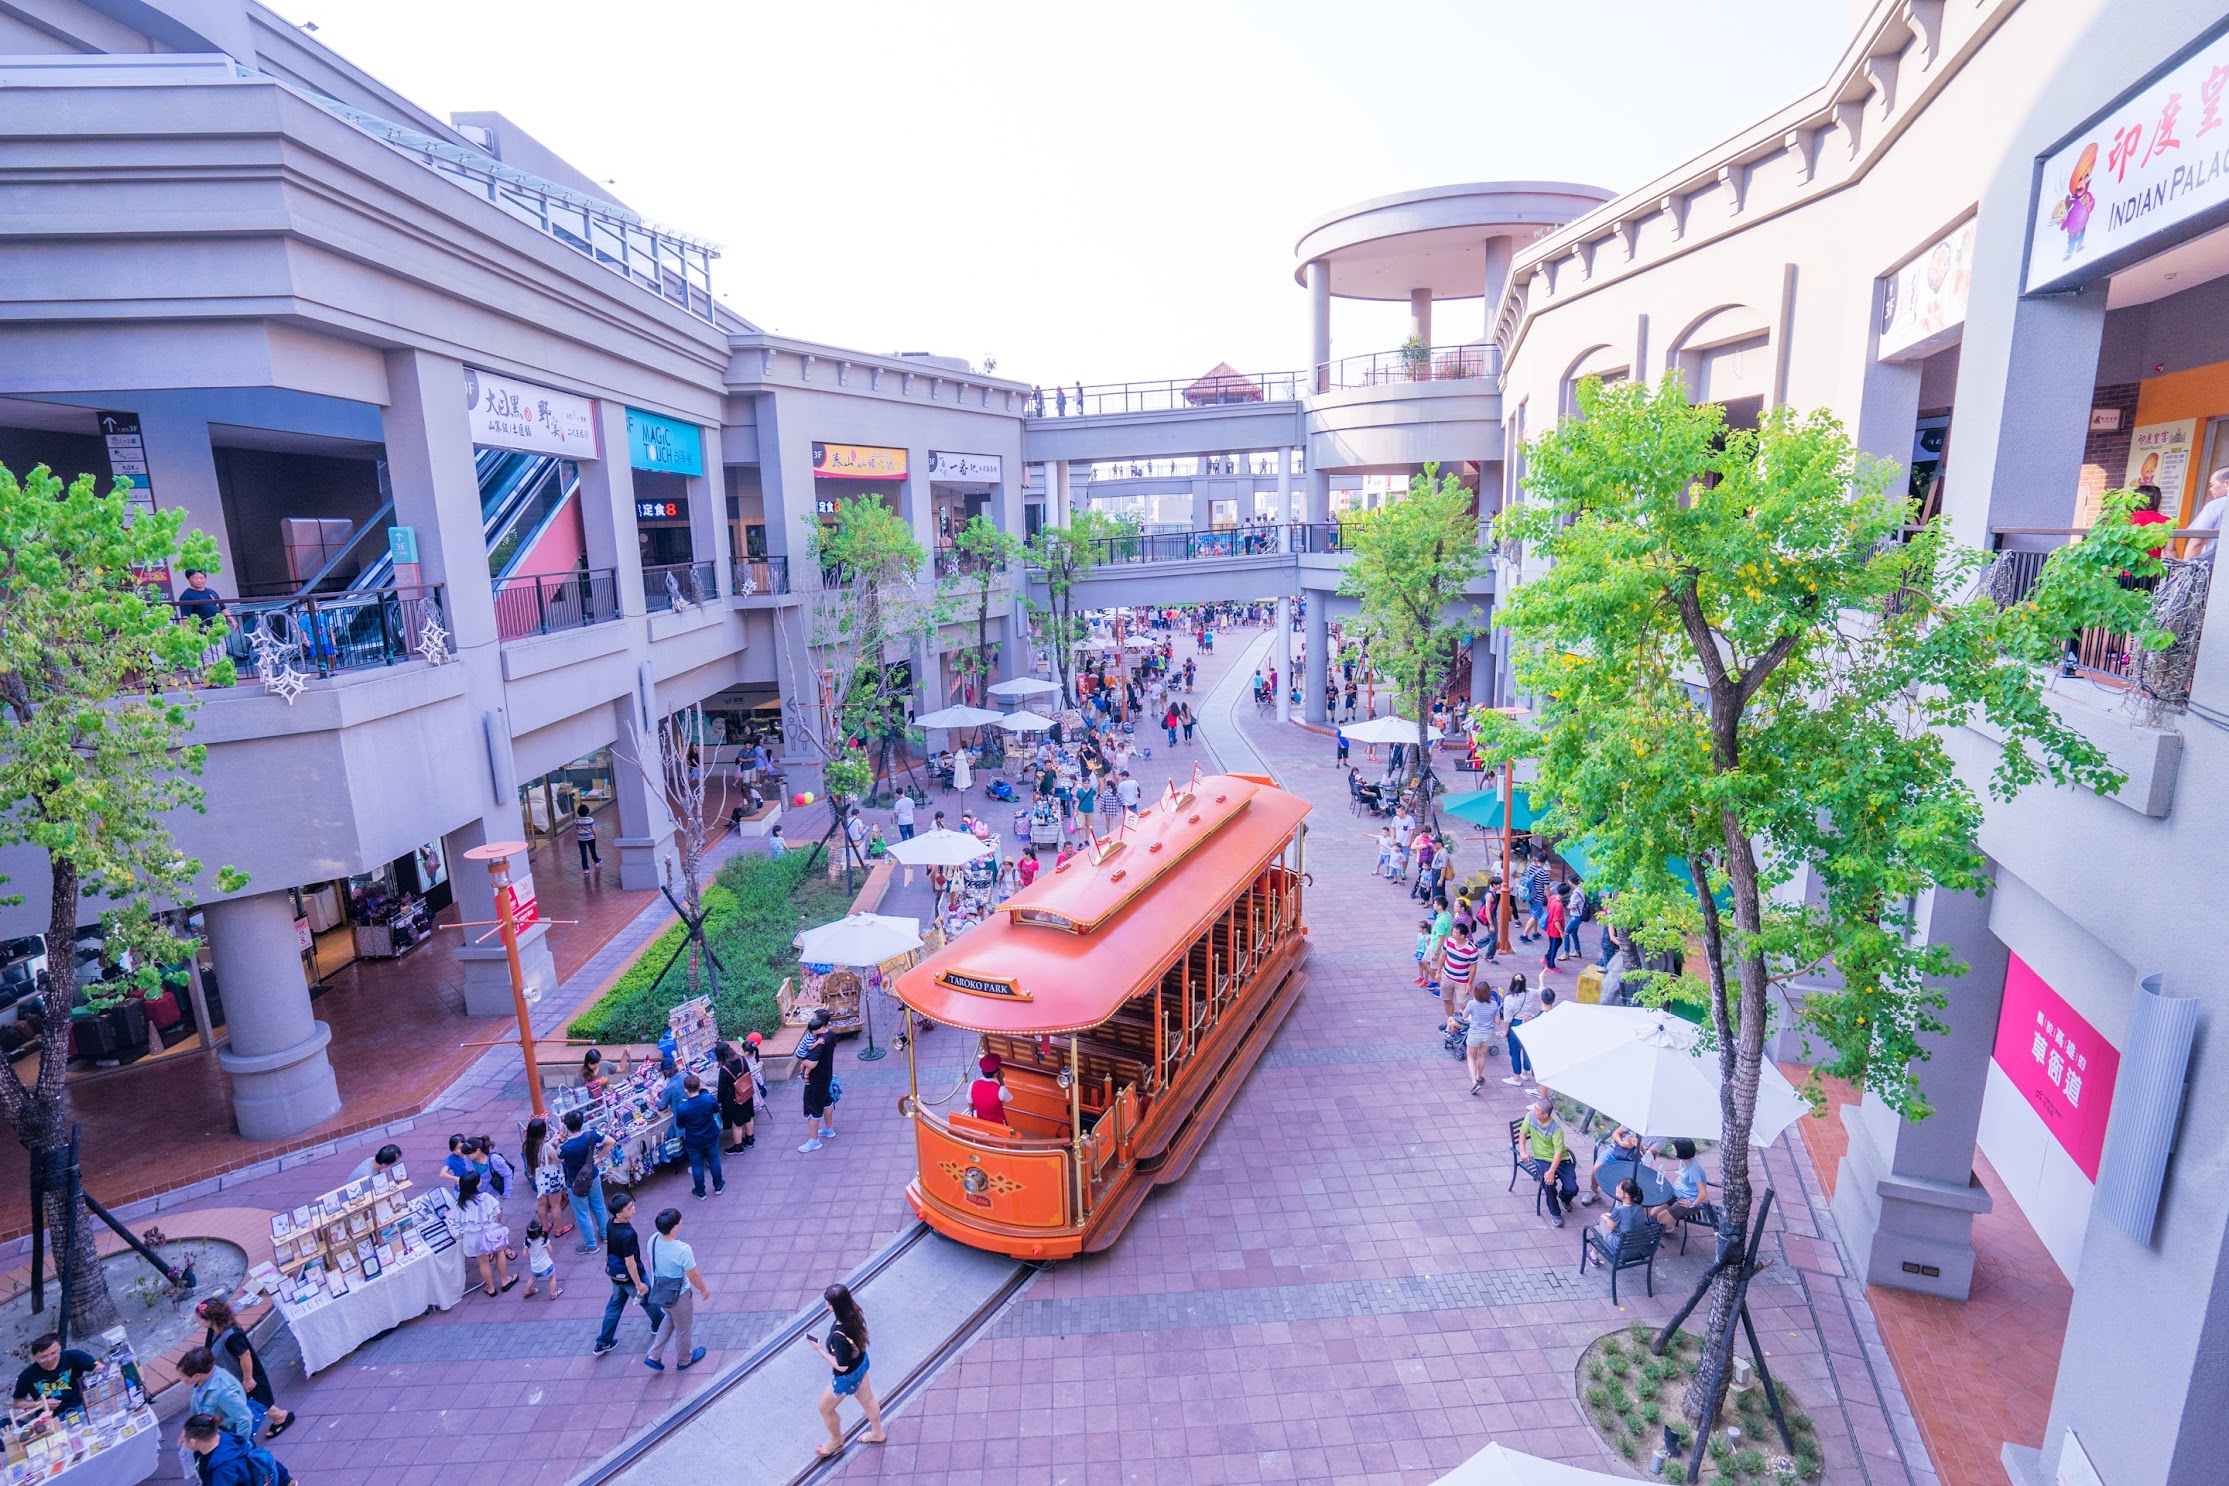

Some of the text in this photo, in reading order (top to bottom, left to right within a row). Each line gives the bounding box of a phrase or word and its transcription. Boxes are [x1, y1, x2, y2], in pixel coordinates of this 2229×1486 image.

[2108, 179, 2168, 232] INDIAN
[1884, 297, 1896, 320] 3F
[643, 443, 673, 464] TOUCH
[813, 450, 822, 459] 3F
[637, 502, 677, 518] 定食8
[949, 975, 1008, 994] TAROKO PARK
[2031, 1030, 2083, 1109] 草衙道
